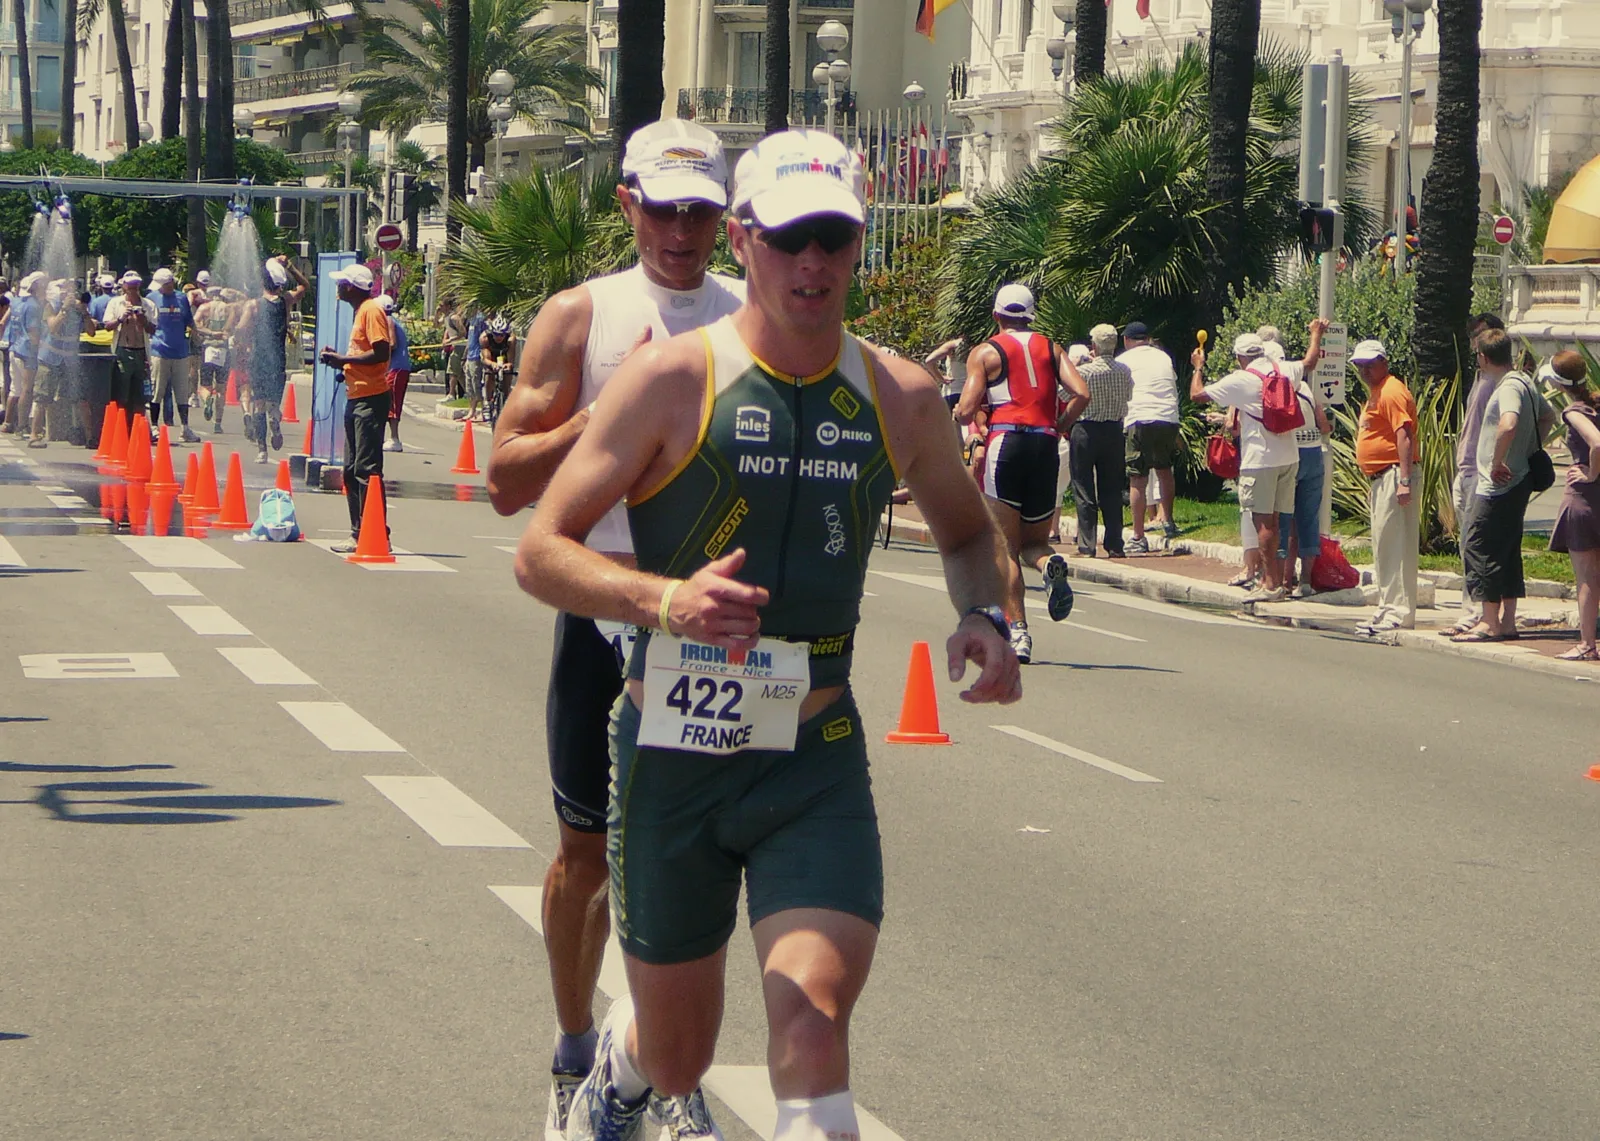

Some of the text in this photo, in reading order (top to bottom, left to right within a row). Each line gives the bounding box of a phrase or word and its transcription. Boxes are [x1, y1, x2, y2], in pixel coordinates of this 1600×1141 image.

[776, 158, 842, 181] IRONMAN
[735, 417, 770, 433] inles
[841, 430, 872, 442] RIKO
[705, 497, 749, 560] SCOTT
[681, 643, 772, 669] IRONMAN
[679, 660, 728, 674] France
[741, 662, 773, 678] Nice
[666, 674, 798, 722] 422 M25
[680, 723, 753, 749] FRANCE
